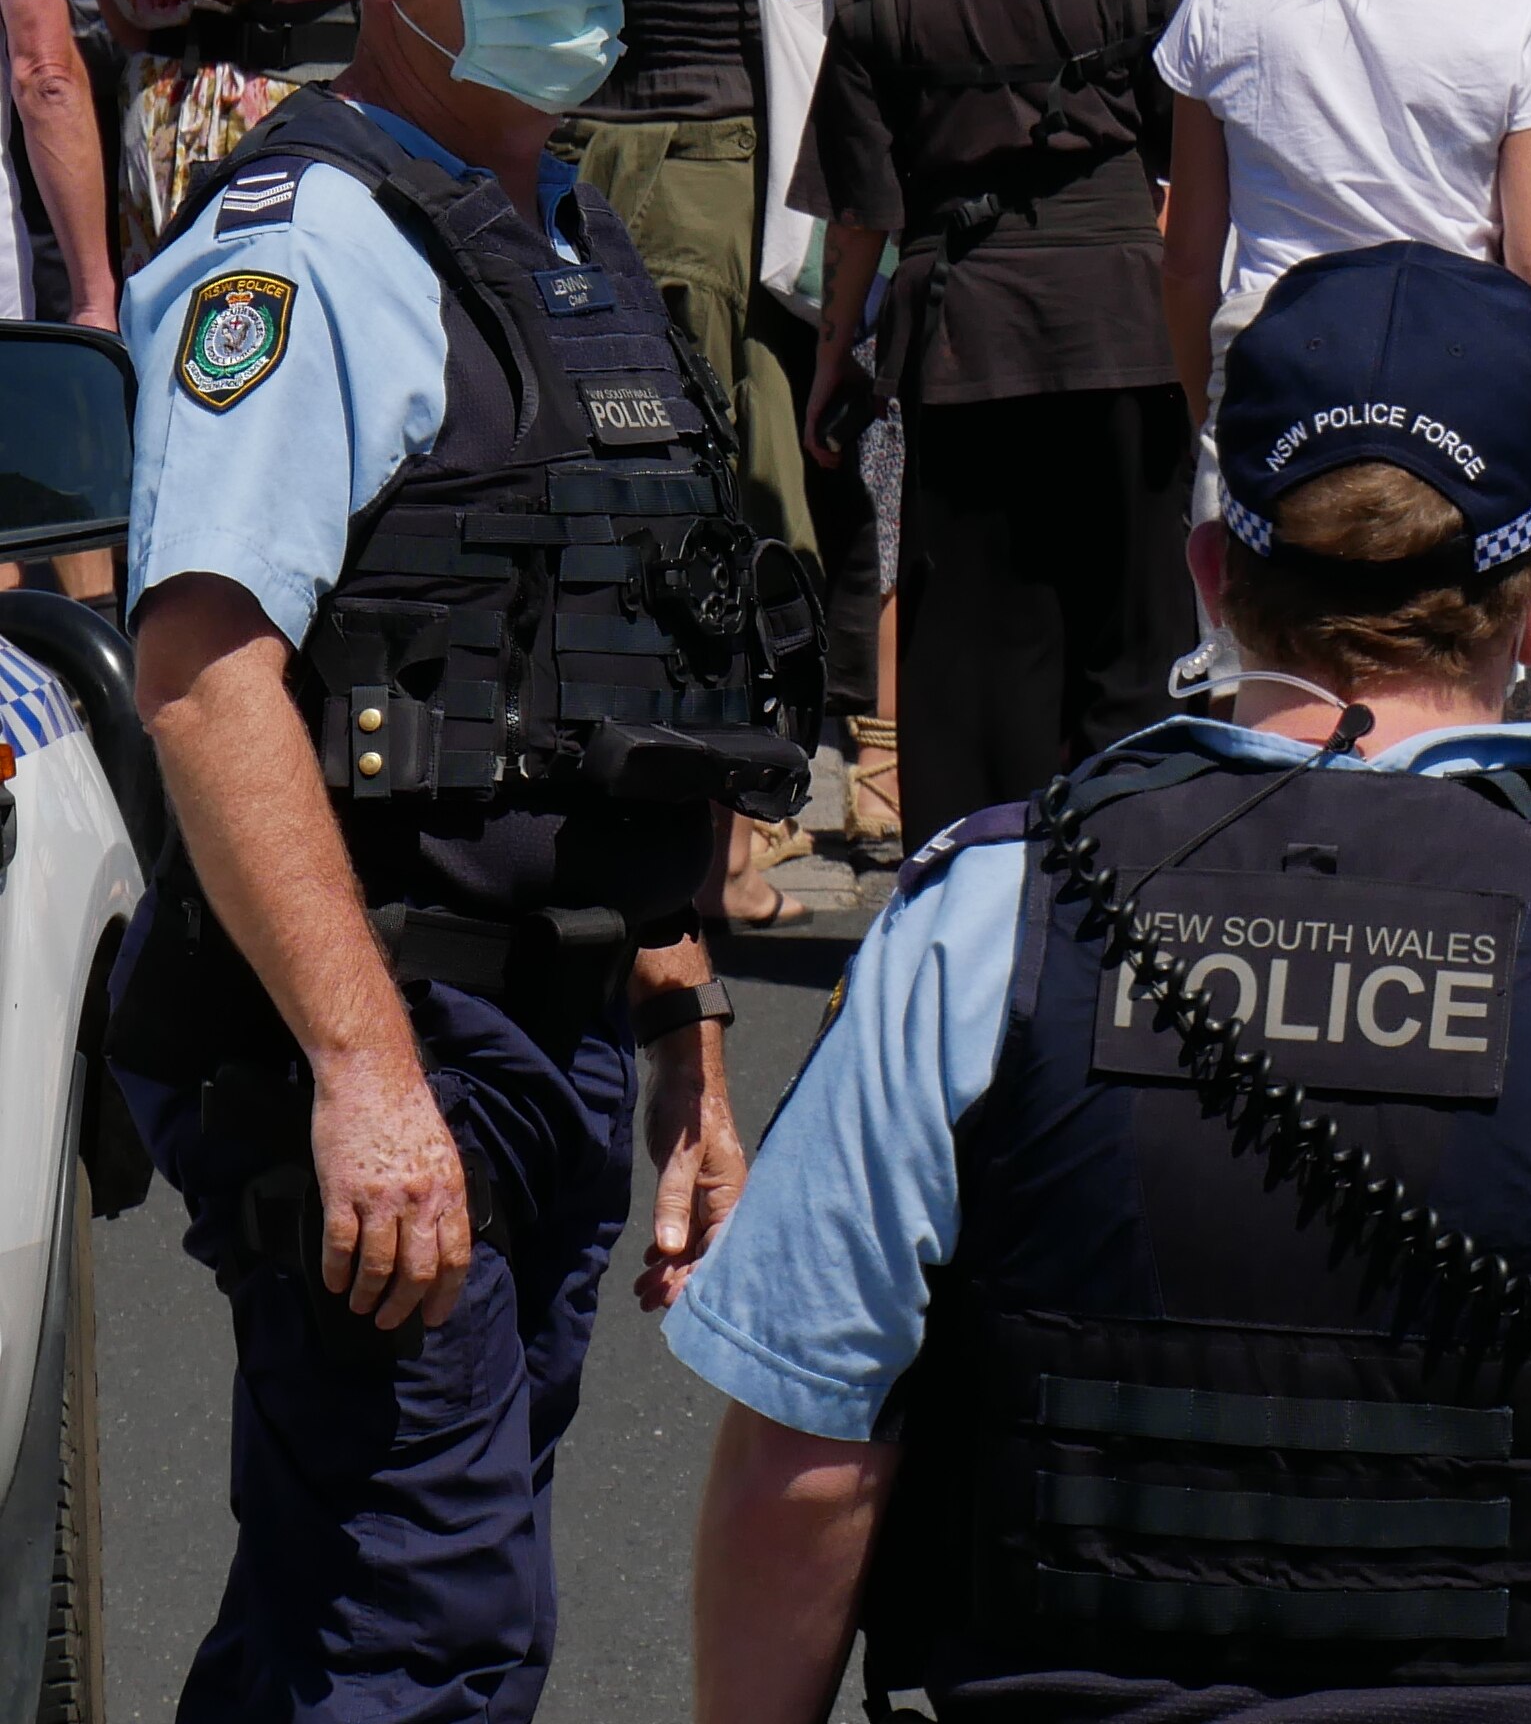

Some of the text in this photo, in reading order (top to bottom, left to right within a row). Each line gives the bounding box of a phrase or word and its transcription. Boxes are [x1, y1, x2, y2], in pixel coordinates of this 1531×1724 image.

[237, 280, 286, 299] POLICE
[590, 400, 672, 429] POLICE
[1265, 403, 1487, 482] NSW POLICE FORCE
[1222, 916, 1353, 953] SOUTH
[1366, 925, 1497, 966] WALES
[1113, 950, 1494, 1053] POLICE
